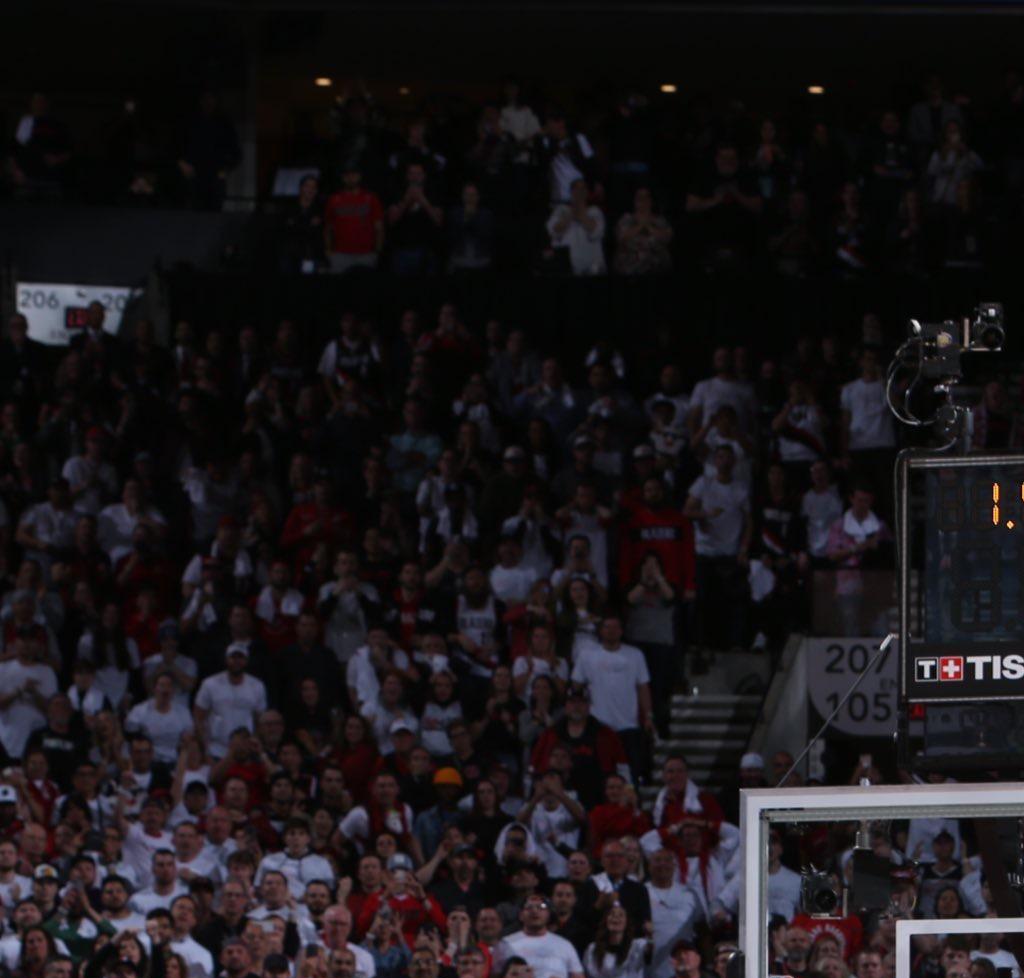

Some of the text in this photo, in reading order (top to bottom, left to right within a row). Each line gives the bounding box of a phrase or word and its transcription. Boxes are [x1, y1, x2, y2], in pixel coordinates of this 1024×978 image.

[20, 289, 60, 308] 206
[825, 645, 891, 674] 207
[825, 693, 891, 722] 105
